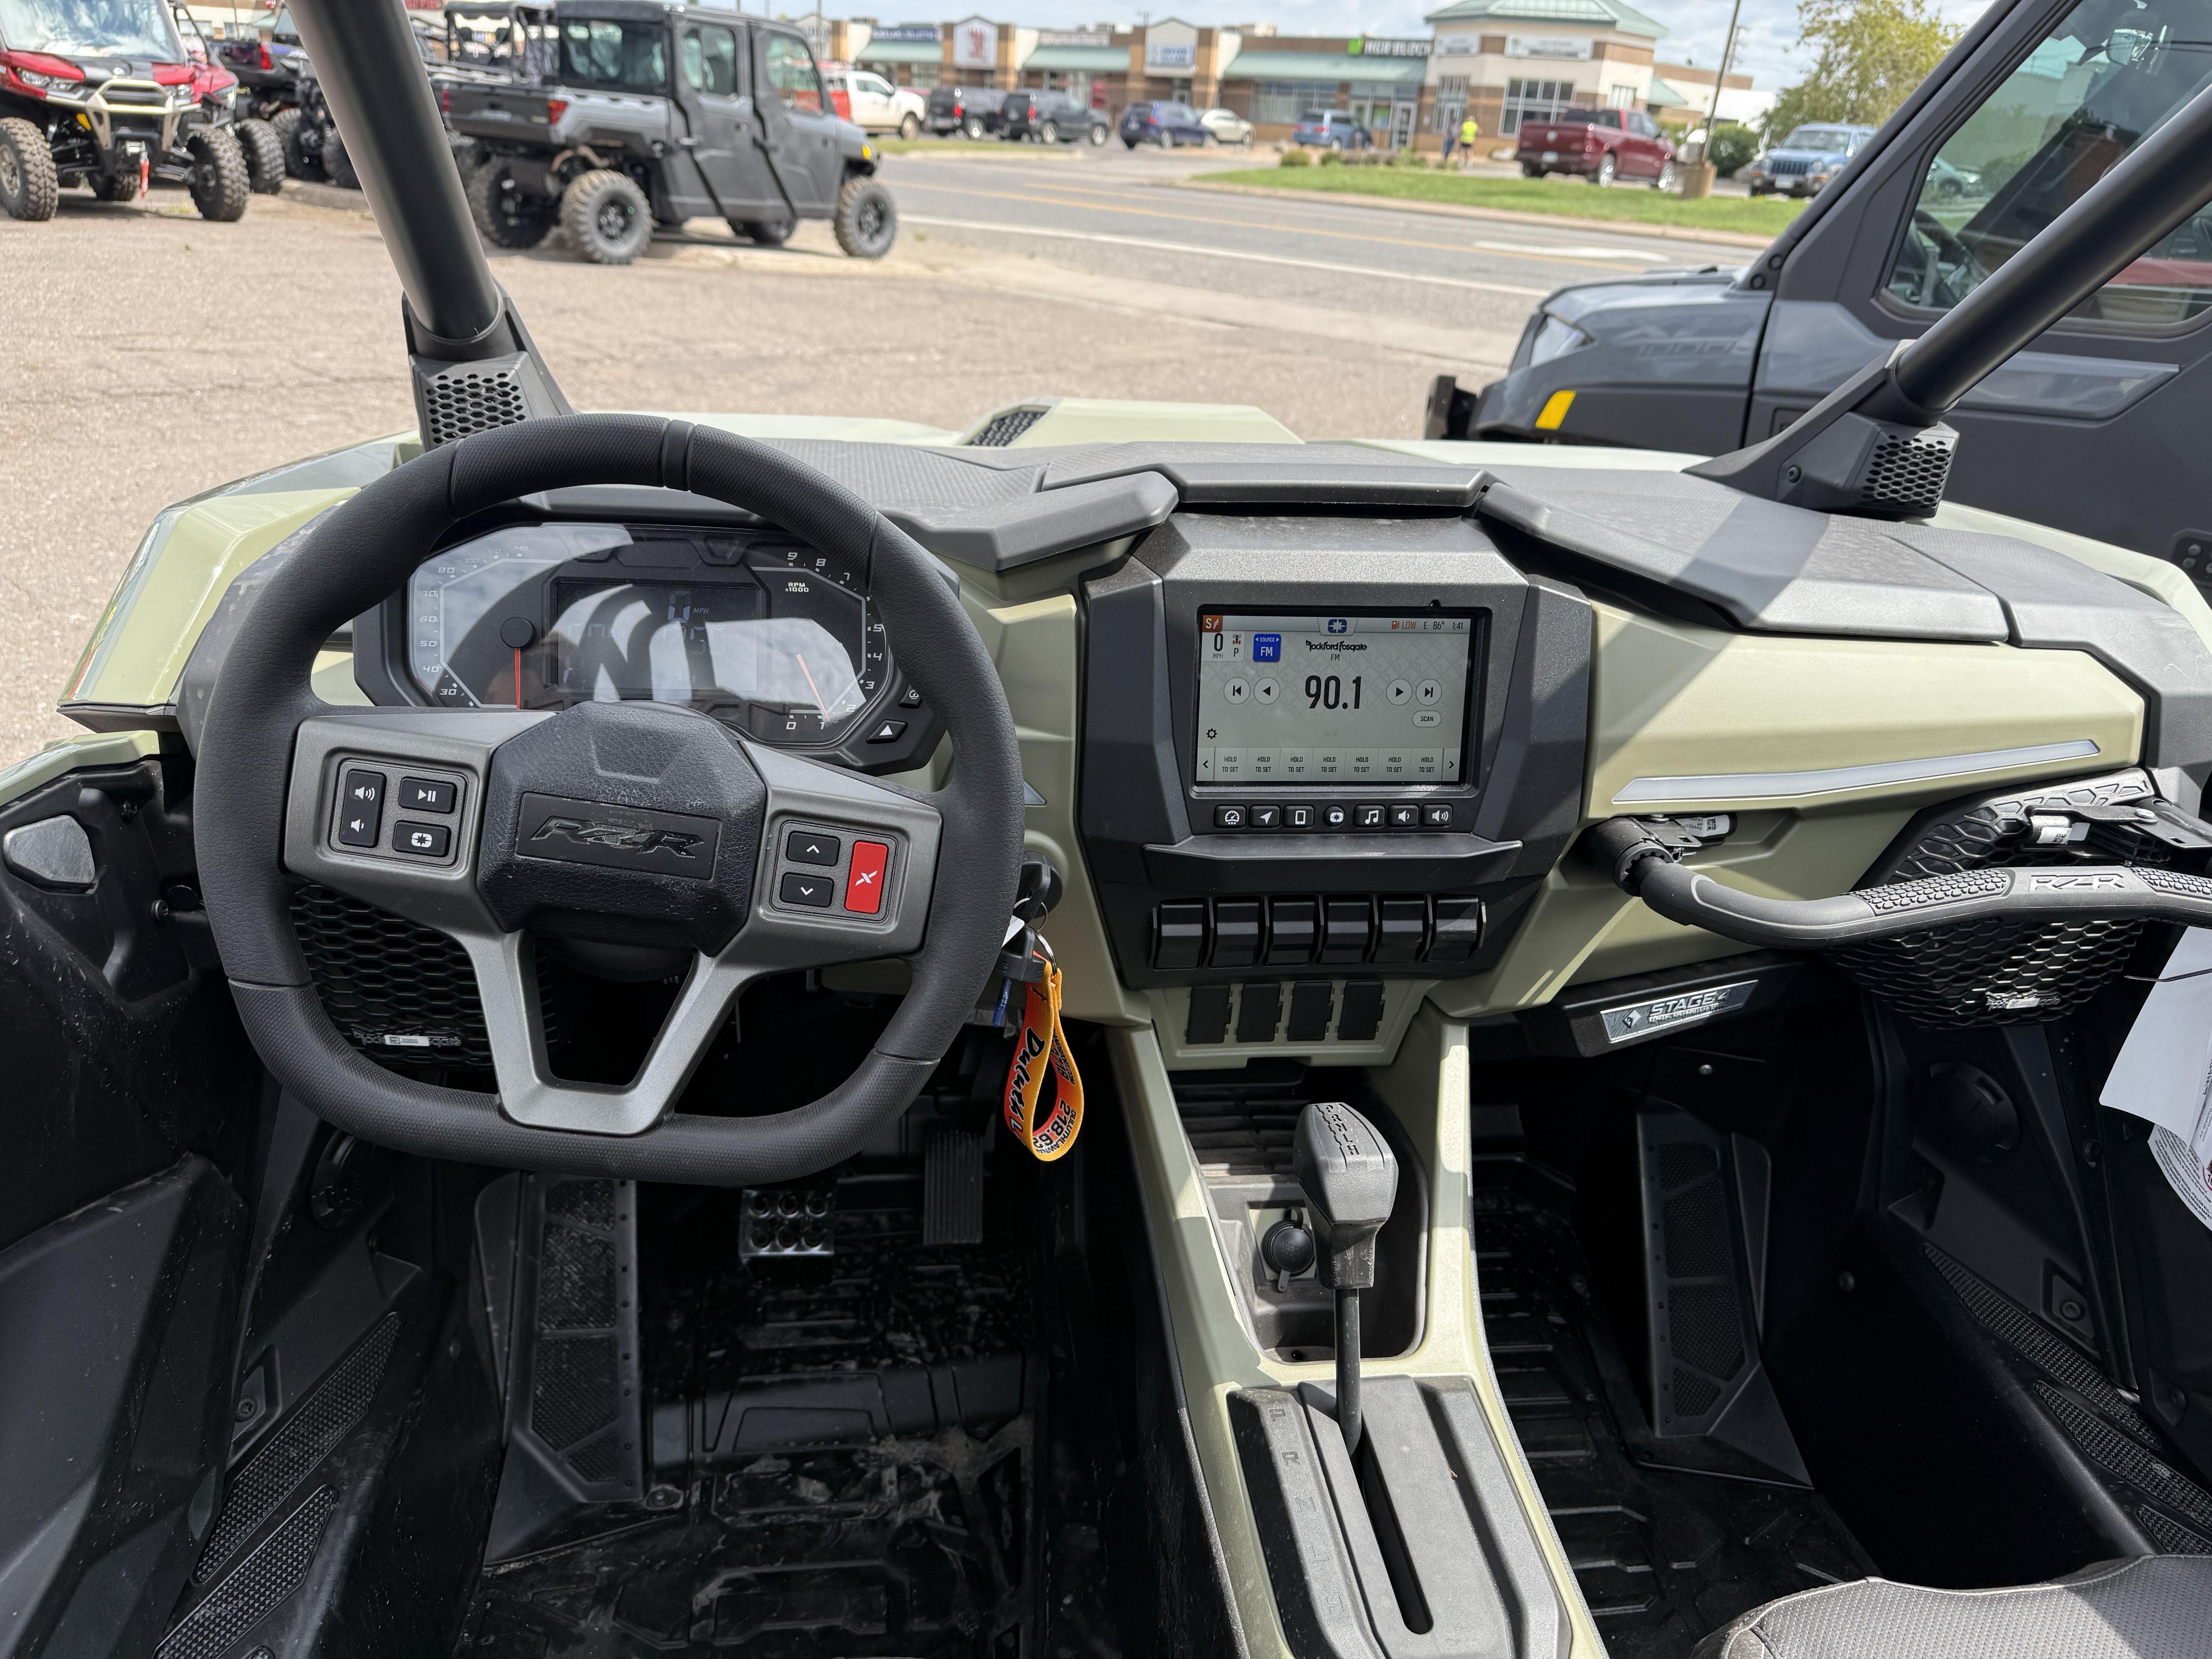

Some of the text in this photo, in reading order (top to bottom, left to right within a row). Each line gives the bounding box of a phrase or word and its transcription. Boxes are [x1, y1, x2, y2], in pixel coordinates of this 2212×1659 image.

[787, 552, 797, 560] 9
[816, 558, 826, 567] 8
[843, 572, 850, 581] 7
[1401, 621, 1417, 630] LOW
[1423, 621, 1427, 629] E
[1433, 621, 1445, 630] 86°
[1452, 622, 1463, 630] 1:41
[1213, 633, 1223, 651] 0
[1305, 640, 1367, 652] Rockford Fosgate
[1233, 648, 1239, 657] P
[1261, 646, 1273, 657] FM
[873, 653, 882, 661] 4
[1331, 654, 1340, 662] FM
[865, 681, 875, 689] 3
[1305, 675, 1362, 710] 90.1
[846, 704, 856, 712] 2
[786, 721, 796, 730] 0
[820, 721, 825, 730] 1
[531, 816, 704, 858] RZR
[2028, 874, 2124, 891] RZR
[1650, 991, 1717, 1017] STAGE
[1717, 989, 1731, 1001] 4
[1009, 1027, 1046, 1133] Duluth L
[1324, 1104, 1333, 1113] P
[1328, 1113, 1342, 1121] R
[1334, 1122, 1348, 1132] N
[1340, 1133, 1353, 1142] L
[1345, 1144, 1360, 1155] H
